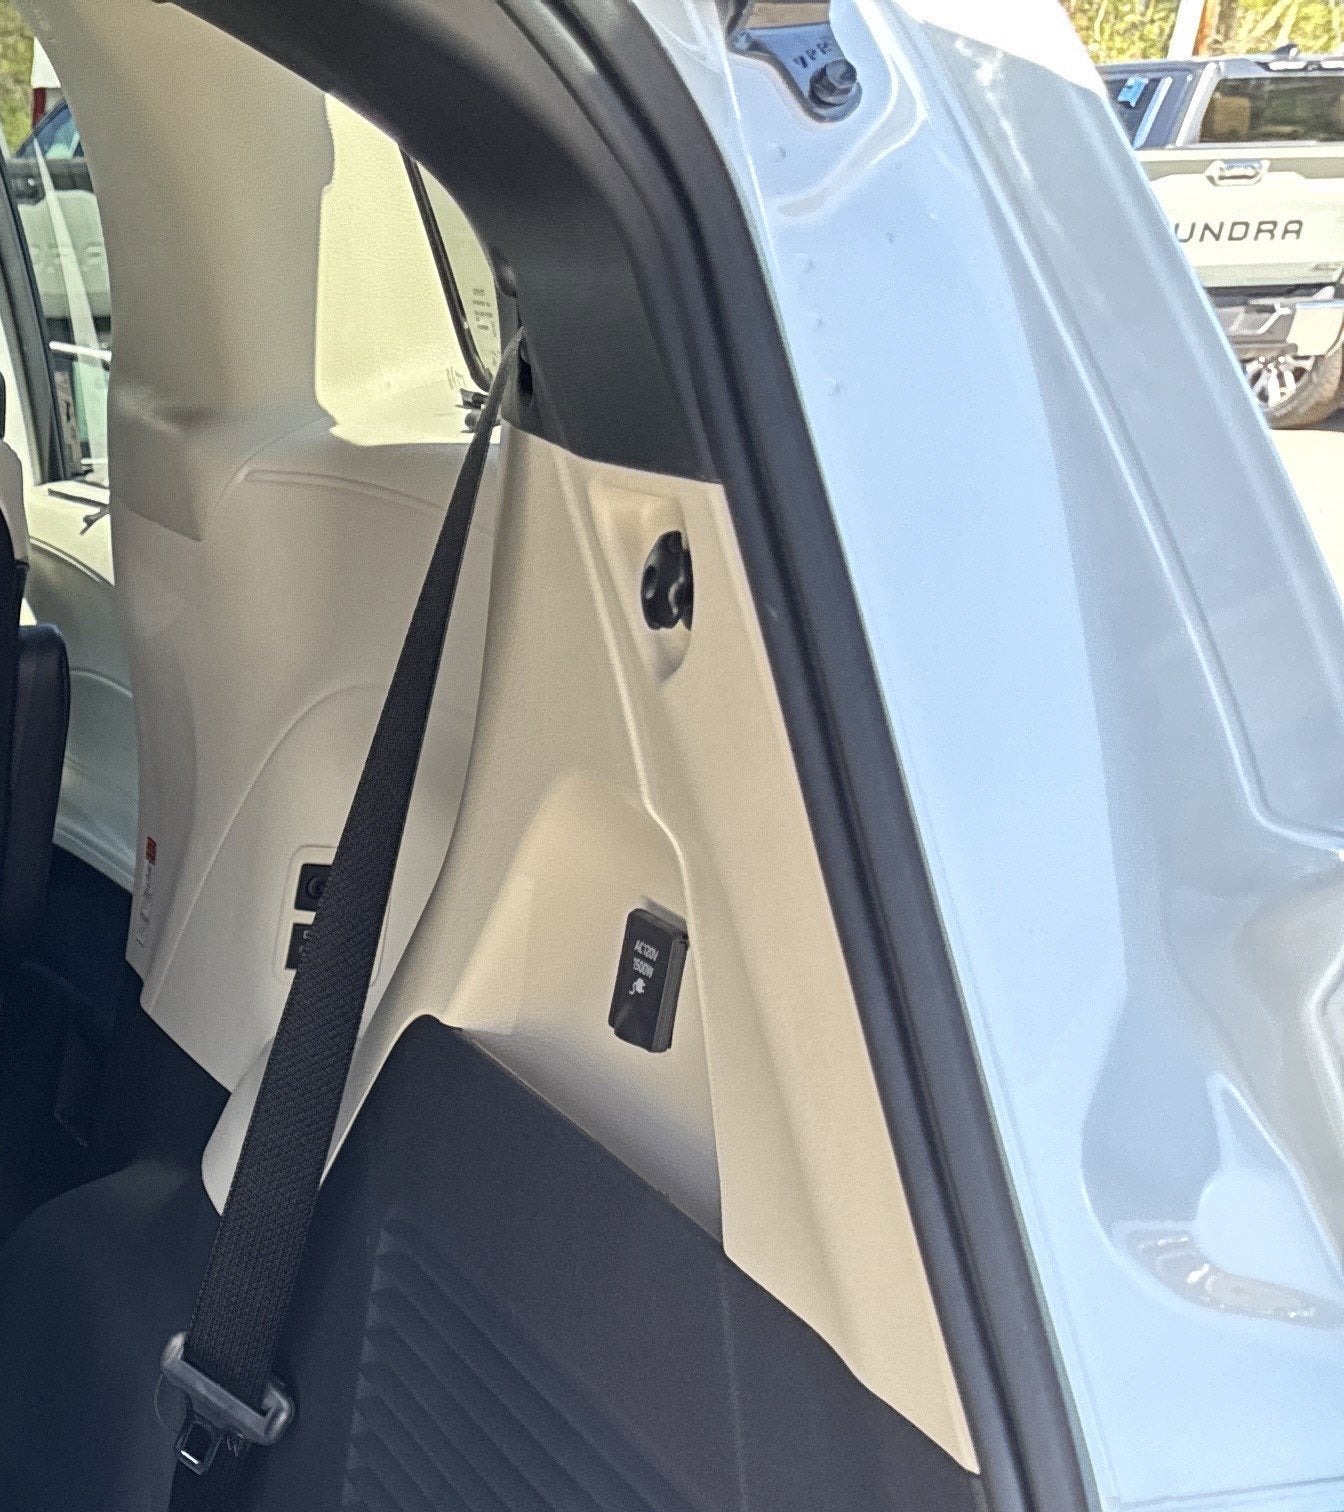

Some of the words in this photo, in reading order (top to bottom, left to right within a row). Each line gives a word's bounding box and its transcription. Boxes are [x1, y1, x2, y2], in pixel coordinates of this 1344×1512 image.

[1174, 219, 1303, 243] UNDRA
[634, 940, 659, 962] AC120V
[633, 957, 654, 979] 1500W
